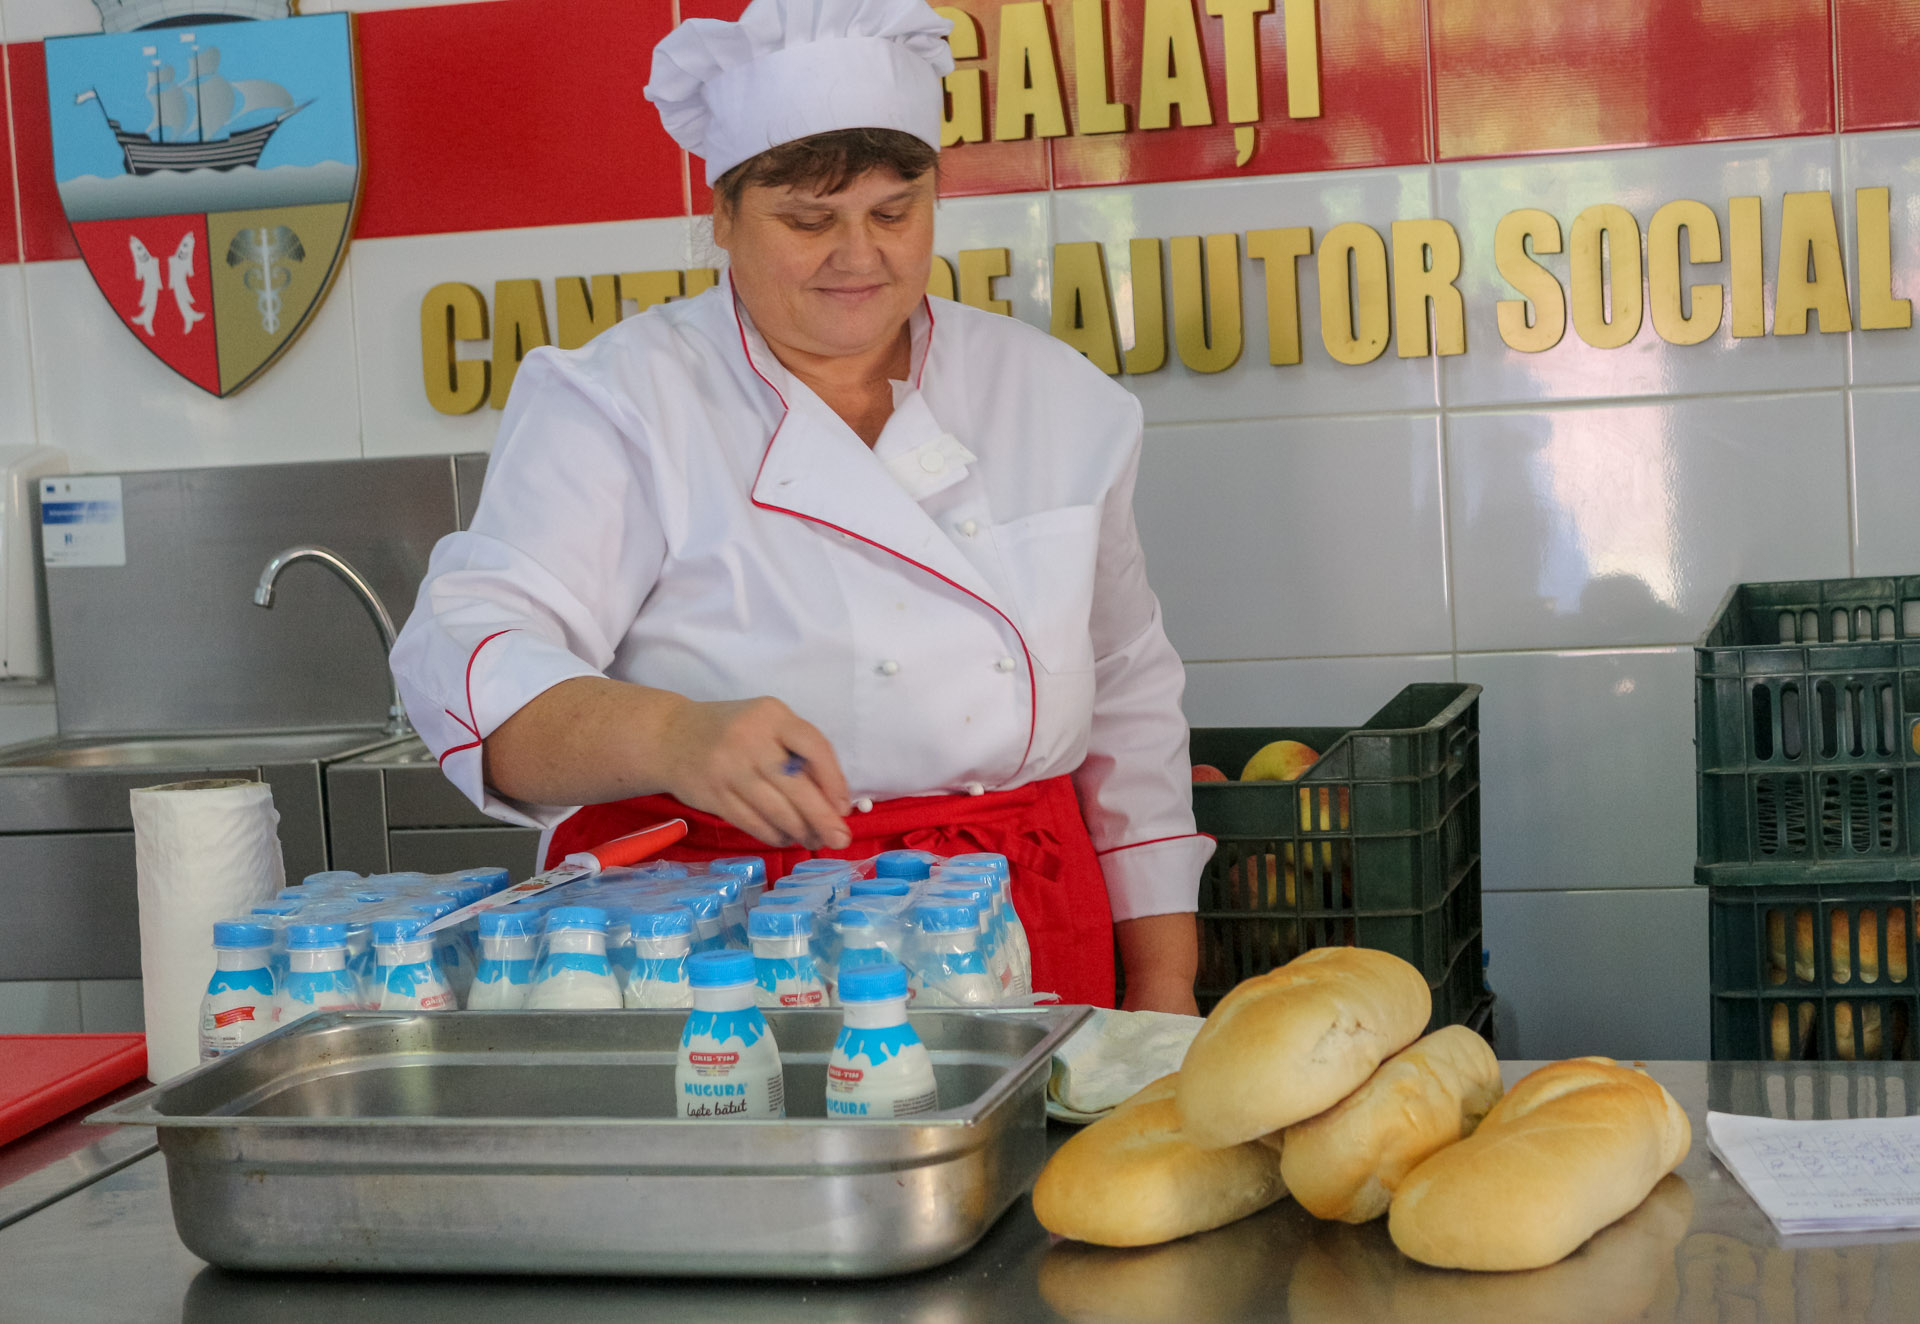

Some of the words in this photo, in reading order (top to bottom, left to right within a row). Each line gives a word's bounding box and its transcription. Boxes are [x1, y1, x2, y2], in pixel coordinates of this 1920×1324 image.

[1048, 219, 1467, 375] AJUTOR
[1494, 187, 1912, 353] SOCIAL
[827, 1097, 868, 1116] UGURA
